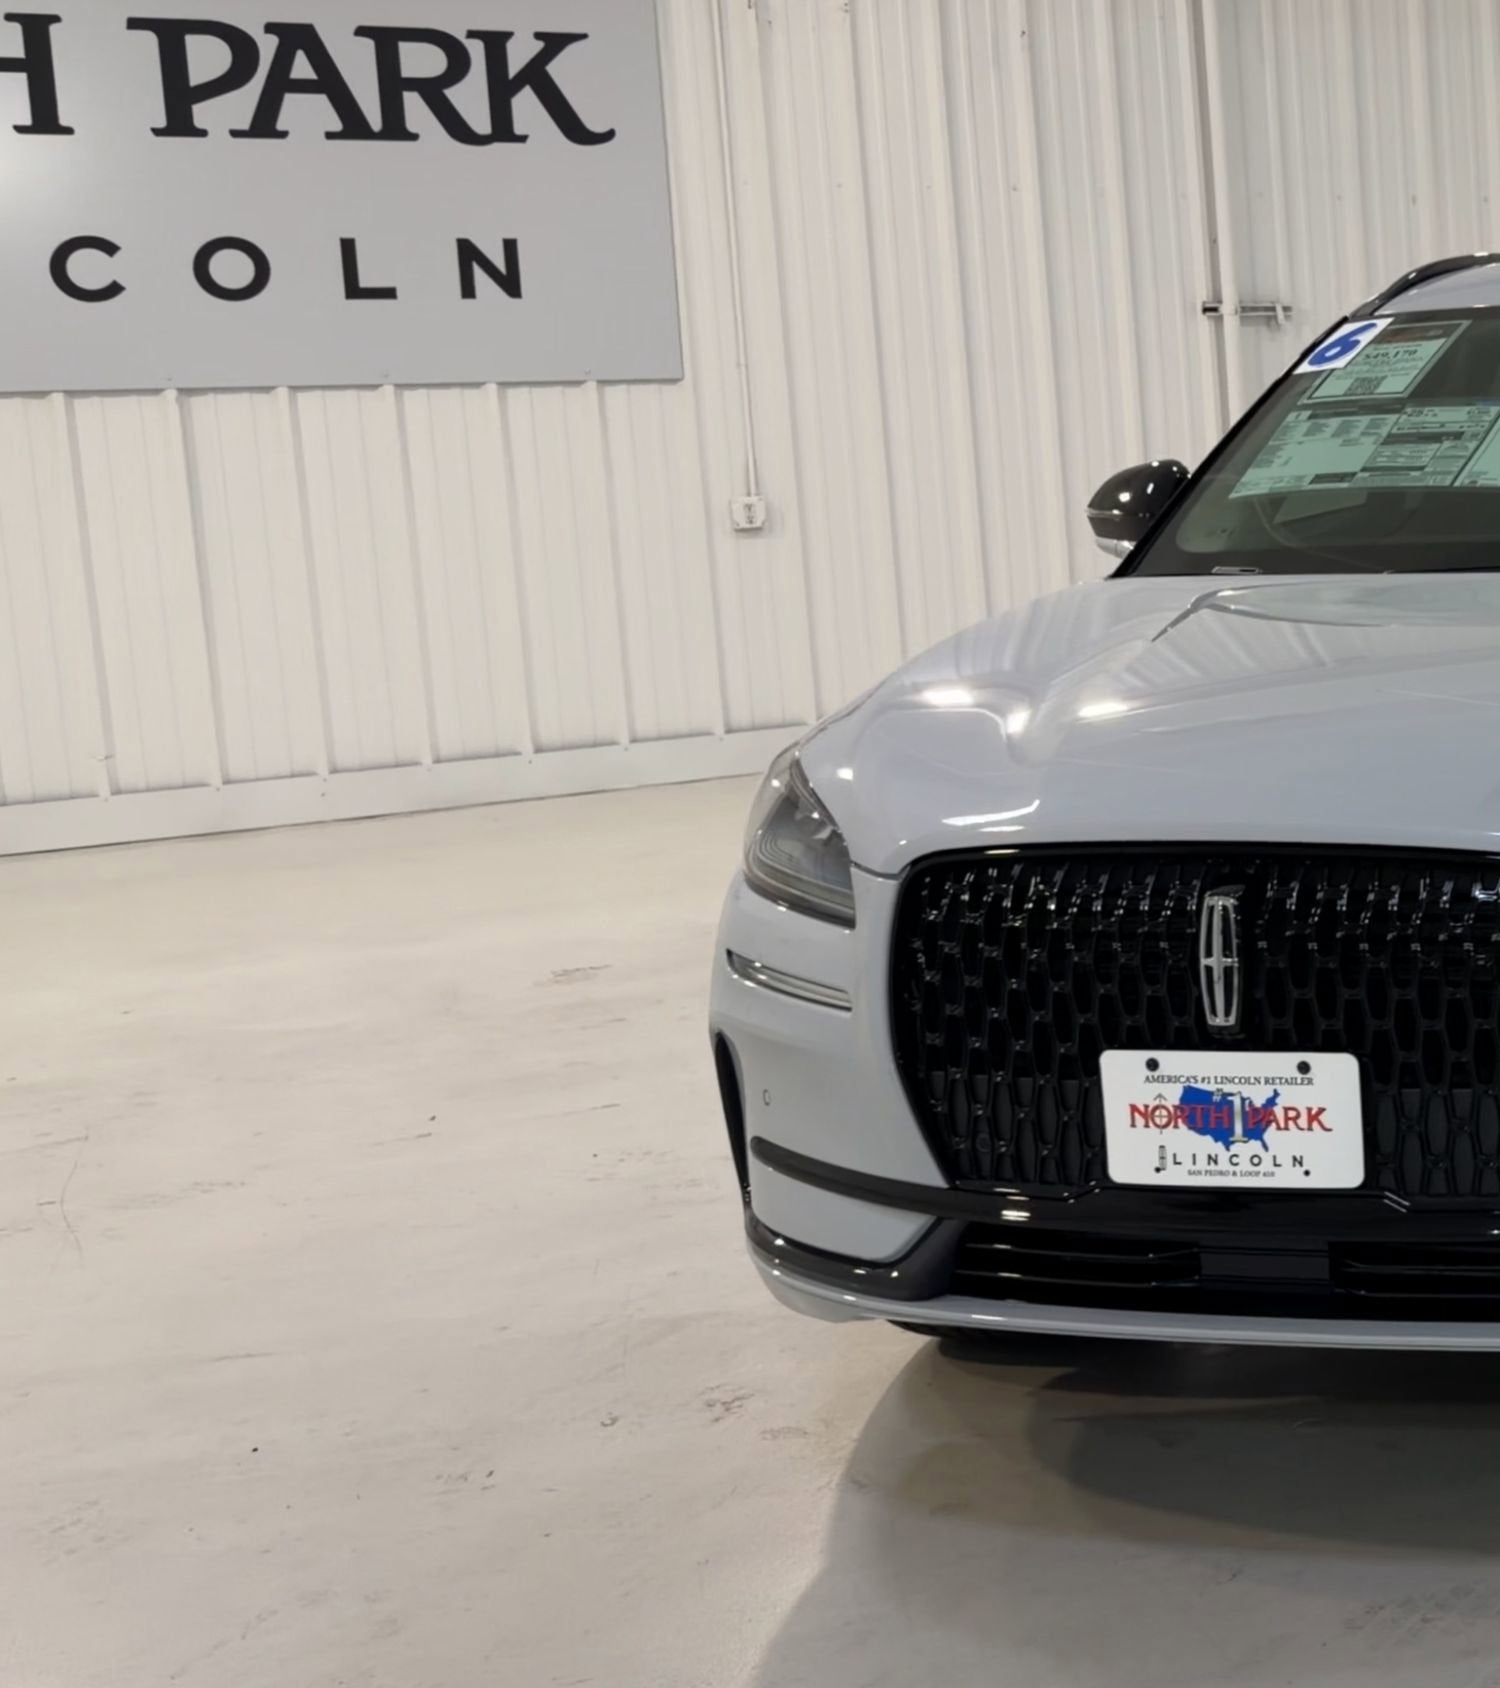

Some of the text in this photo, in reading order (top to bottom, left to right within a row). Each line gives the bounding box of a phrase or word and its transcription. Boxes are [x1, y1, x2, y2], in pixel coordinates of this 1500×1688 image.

[126, 17, 616, 146] PARK
[49, 235, 523, 302] COLN
[1308, 322, 1377, 368] 6
[1144, 1075, 1314, 1086] AMERICA'S #1 LINCOLN RETAILER
[1129, 1104, 1333, 1132] NORTH PARK
[1173, 1152, 1303, 1167] LINCOLN
[1204, 1169, 1230, 1177] PEDRO
